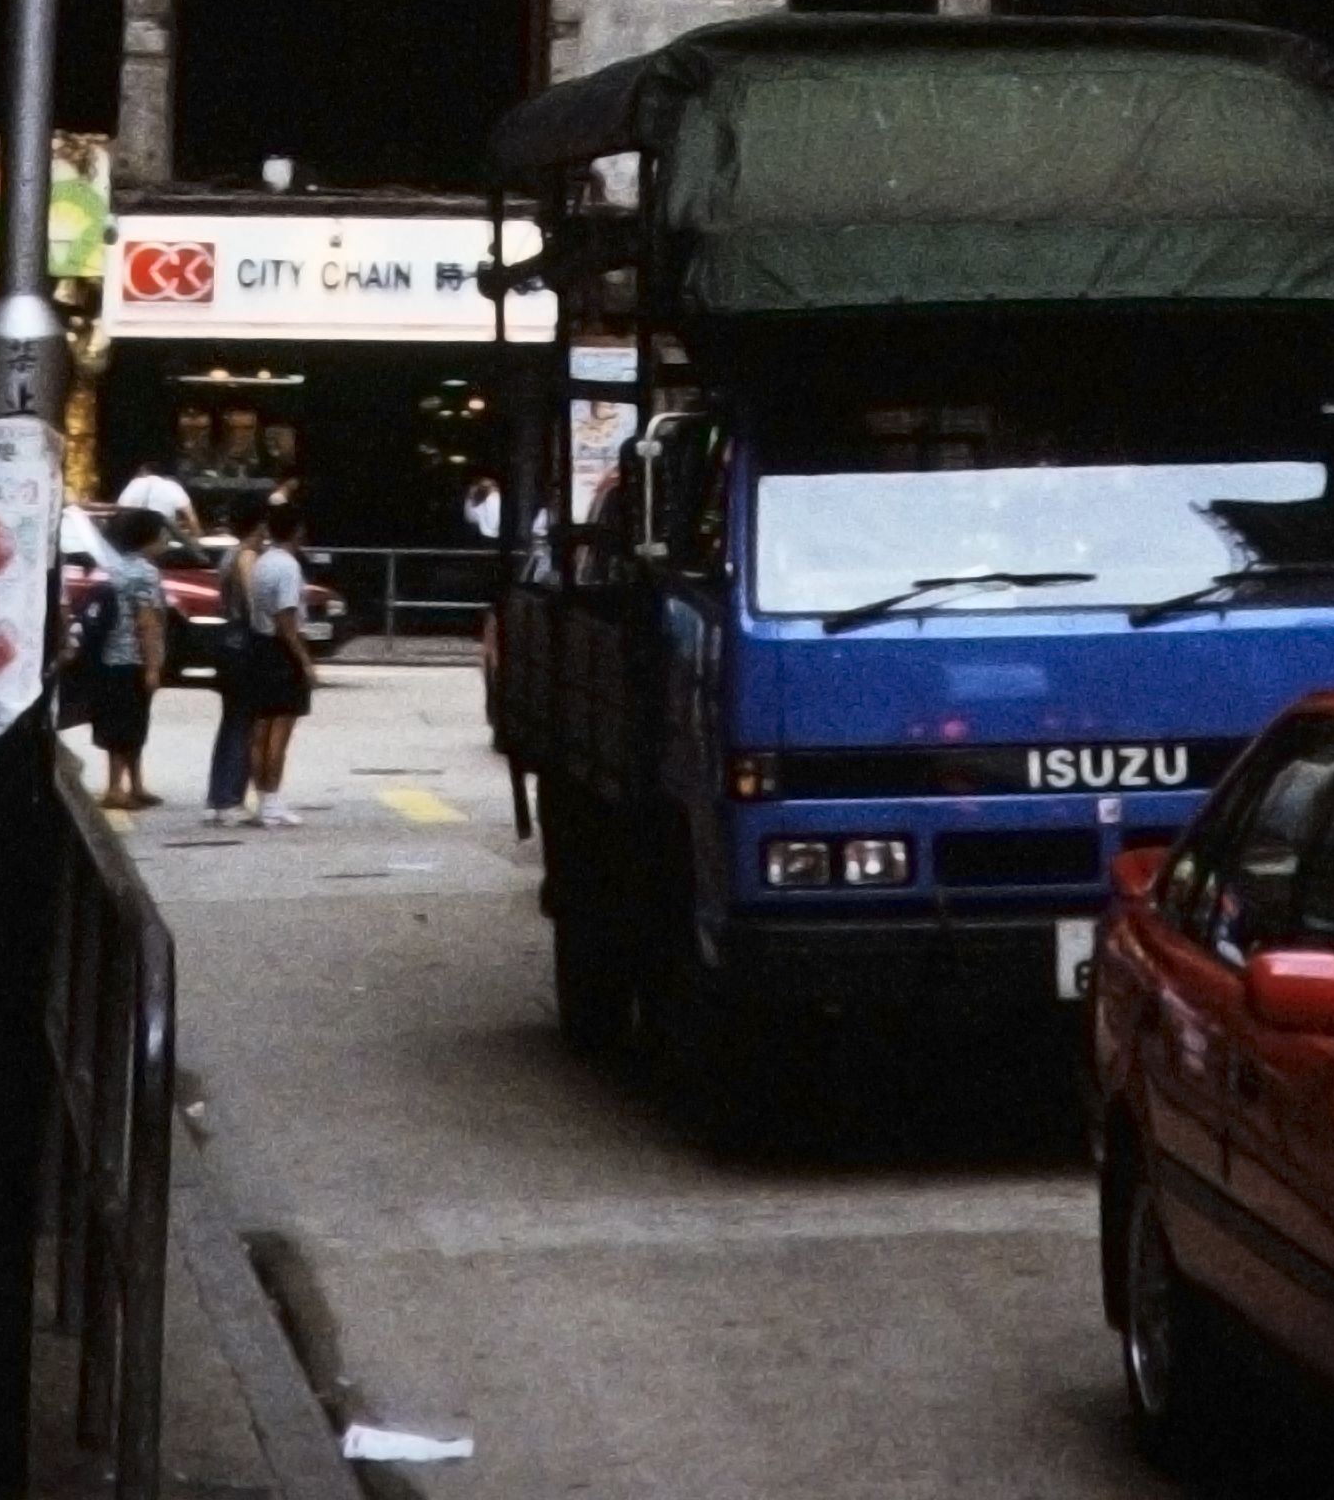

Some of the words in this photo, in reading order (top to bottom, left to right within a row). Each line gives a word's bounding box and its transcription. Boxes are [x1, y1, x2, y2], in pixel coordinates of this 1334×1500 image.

[236, 258, 304, 290] CITY
[320, 260, 412, 291] CHAIN
[1027, 746, 1188, 788] ISUZU
